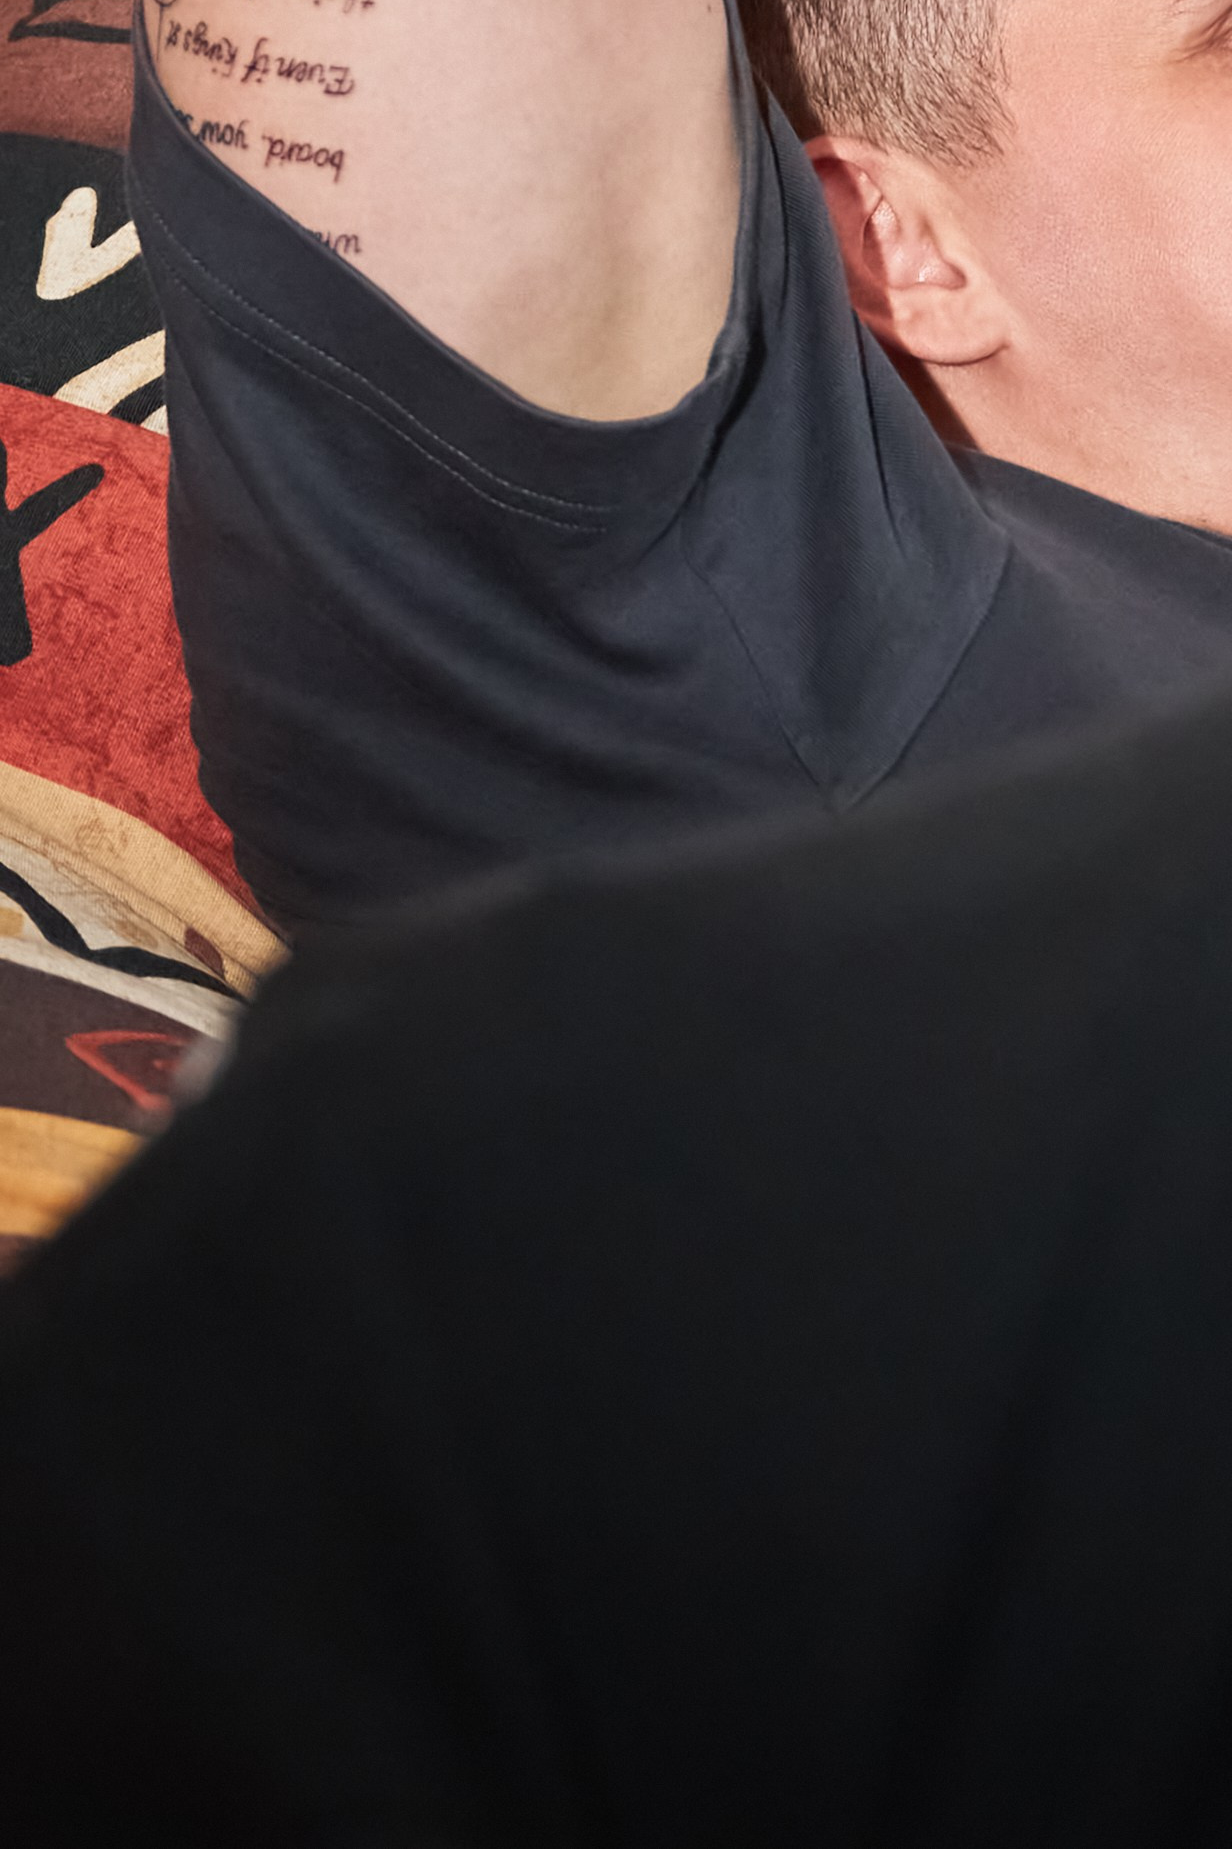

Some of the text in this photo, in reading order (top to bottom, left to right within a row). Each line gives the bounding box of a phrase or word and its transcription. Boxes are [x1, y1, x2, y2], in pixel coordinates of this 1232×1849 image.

[183, 21, 238, 78] kings
[240, 37, 270, 84] if
[277, 52, 355, 96] Even
